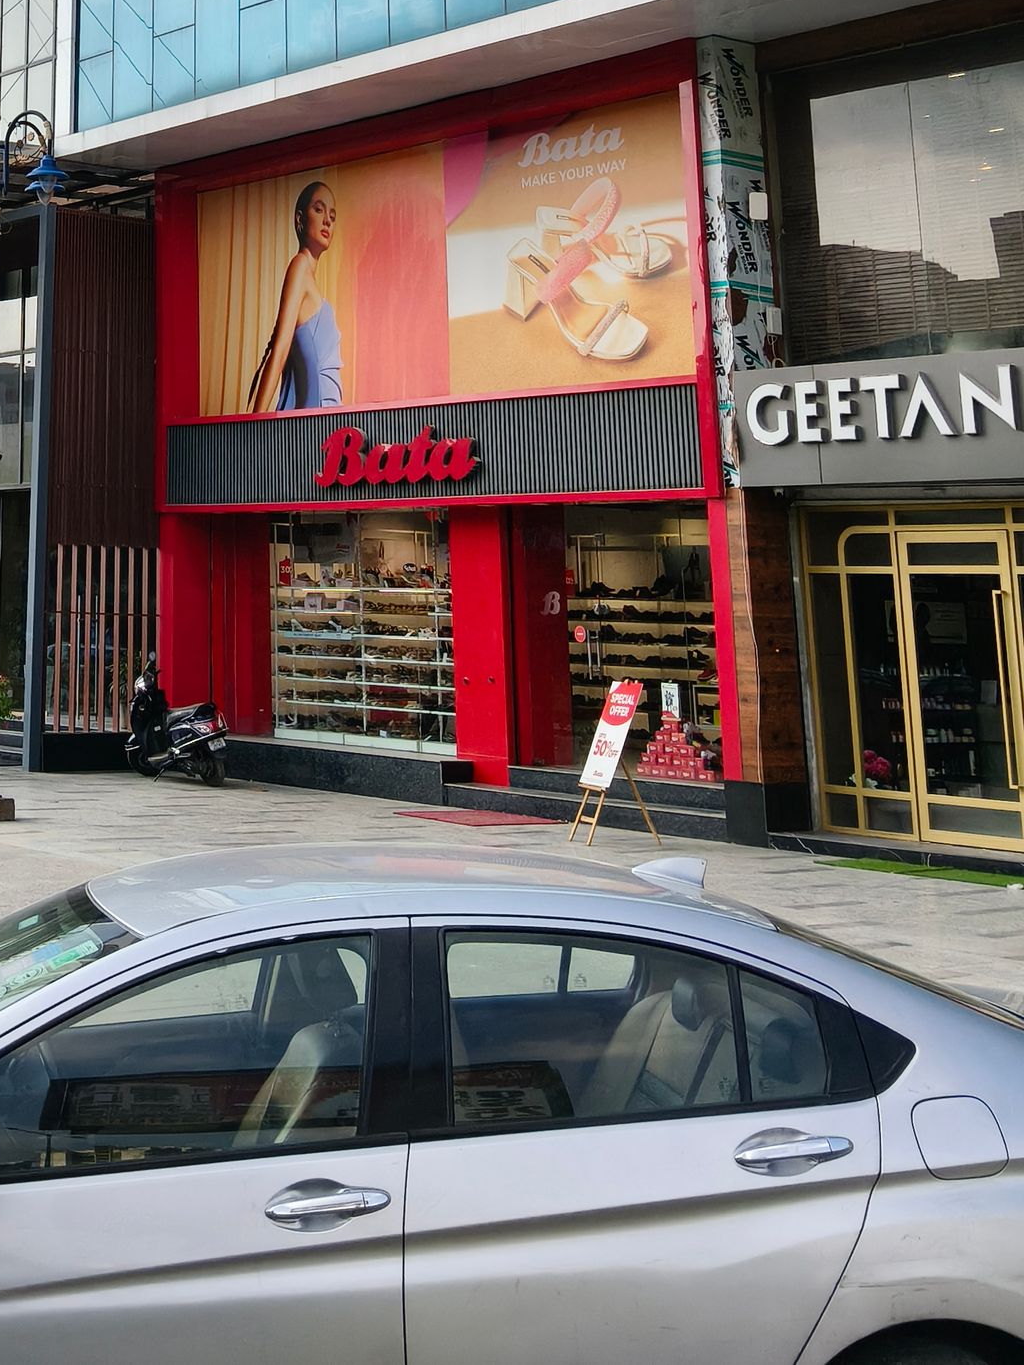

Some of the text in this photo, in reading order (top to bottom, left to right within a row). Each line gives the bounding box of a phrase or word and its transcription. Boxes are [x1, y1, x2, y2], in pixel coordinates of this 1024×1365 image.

[721, 48, 753, 118] WONDER
[518, 124, 624, 167] Bata
[521, 159, 626, 189] MAKE YOUR WAY
[726, 201, 758, 273] WONDER
[313, 425, 481, 487] Bata
[609, 705, 630, 717] OFFER
[610, 692, 635, 705] SPECIAL
